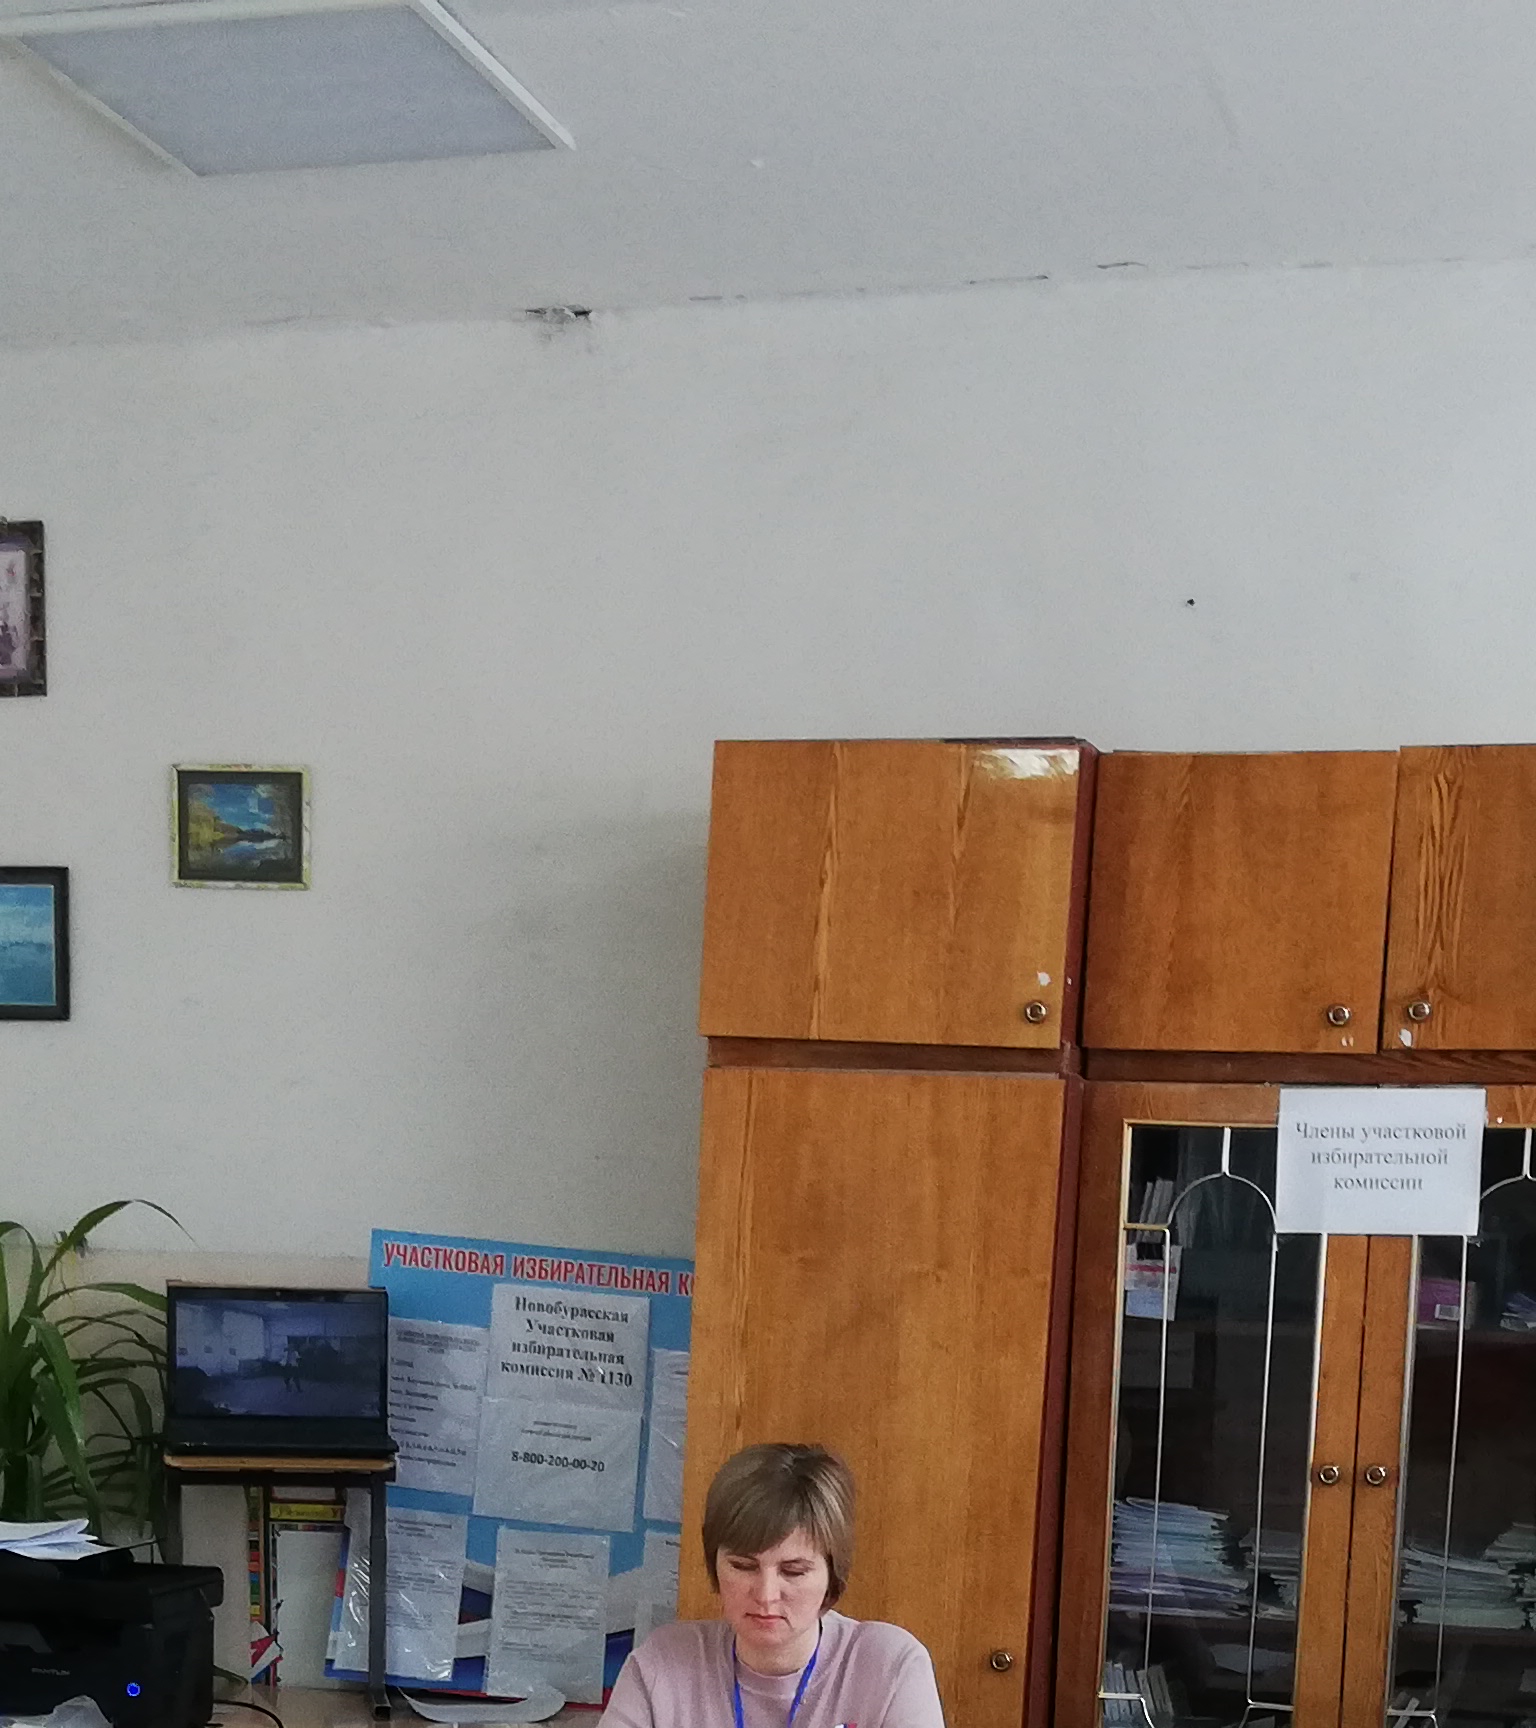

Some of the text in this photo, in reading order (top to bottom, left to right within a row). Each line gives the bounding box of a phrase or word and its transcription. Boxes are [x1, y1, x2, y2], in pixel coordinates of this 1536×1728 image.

[1295, 1121, 1467, 1144] Члены участковой
[1311, 1147, 1449, 1168] избирательной
[1333, 1176, 1424, 1191] комиссии
[383, 1242, 505, 1277] УЧАСТКОВАЯ
[512, 1255, 671, 1294] ИЗБИРАТЕЛЬНАЯ
[525, 1317, 616, 1344] Участковая
[511, 1340, 626, 1367] избирательная
[500, 1360, 574, 1380] комиссия
[511, 1450, 605, 1473] 8-800-200-00-20
